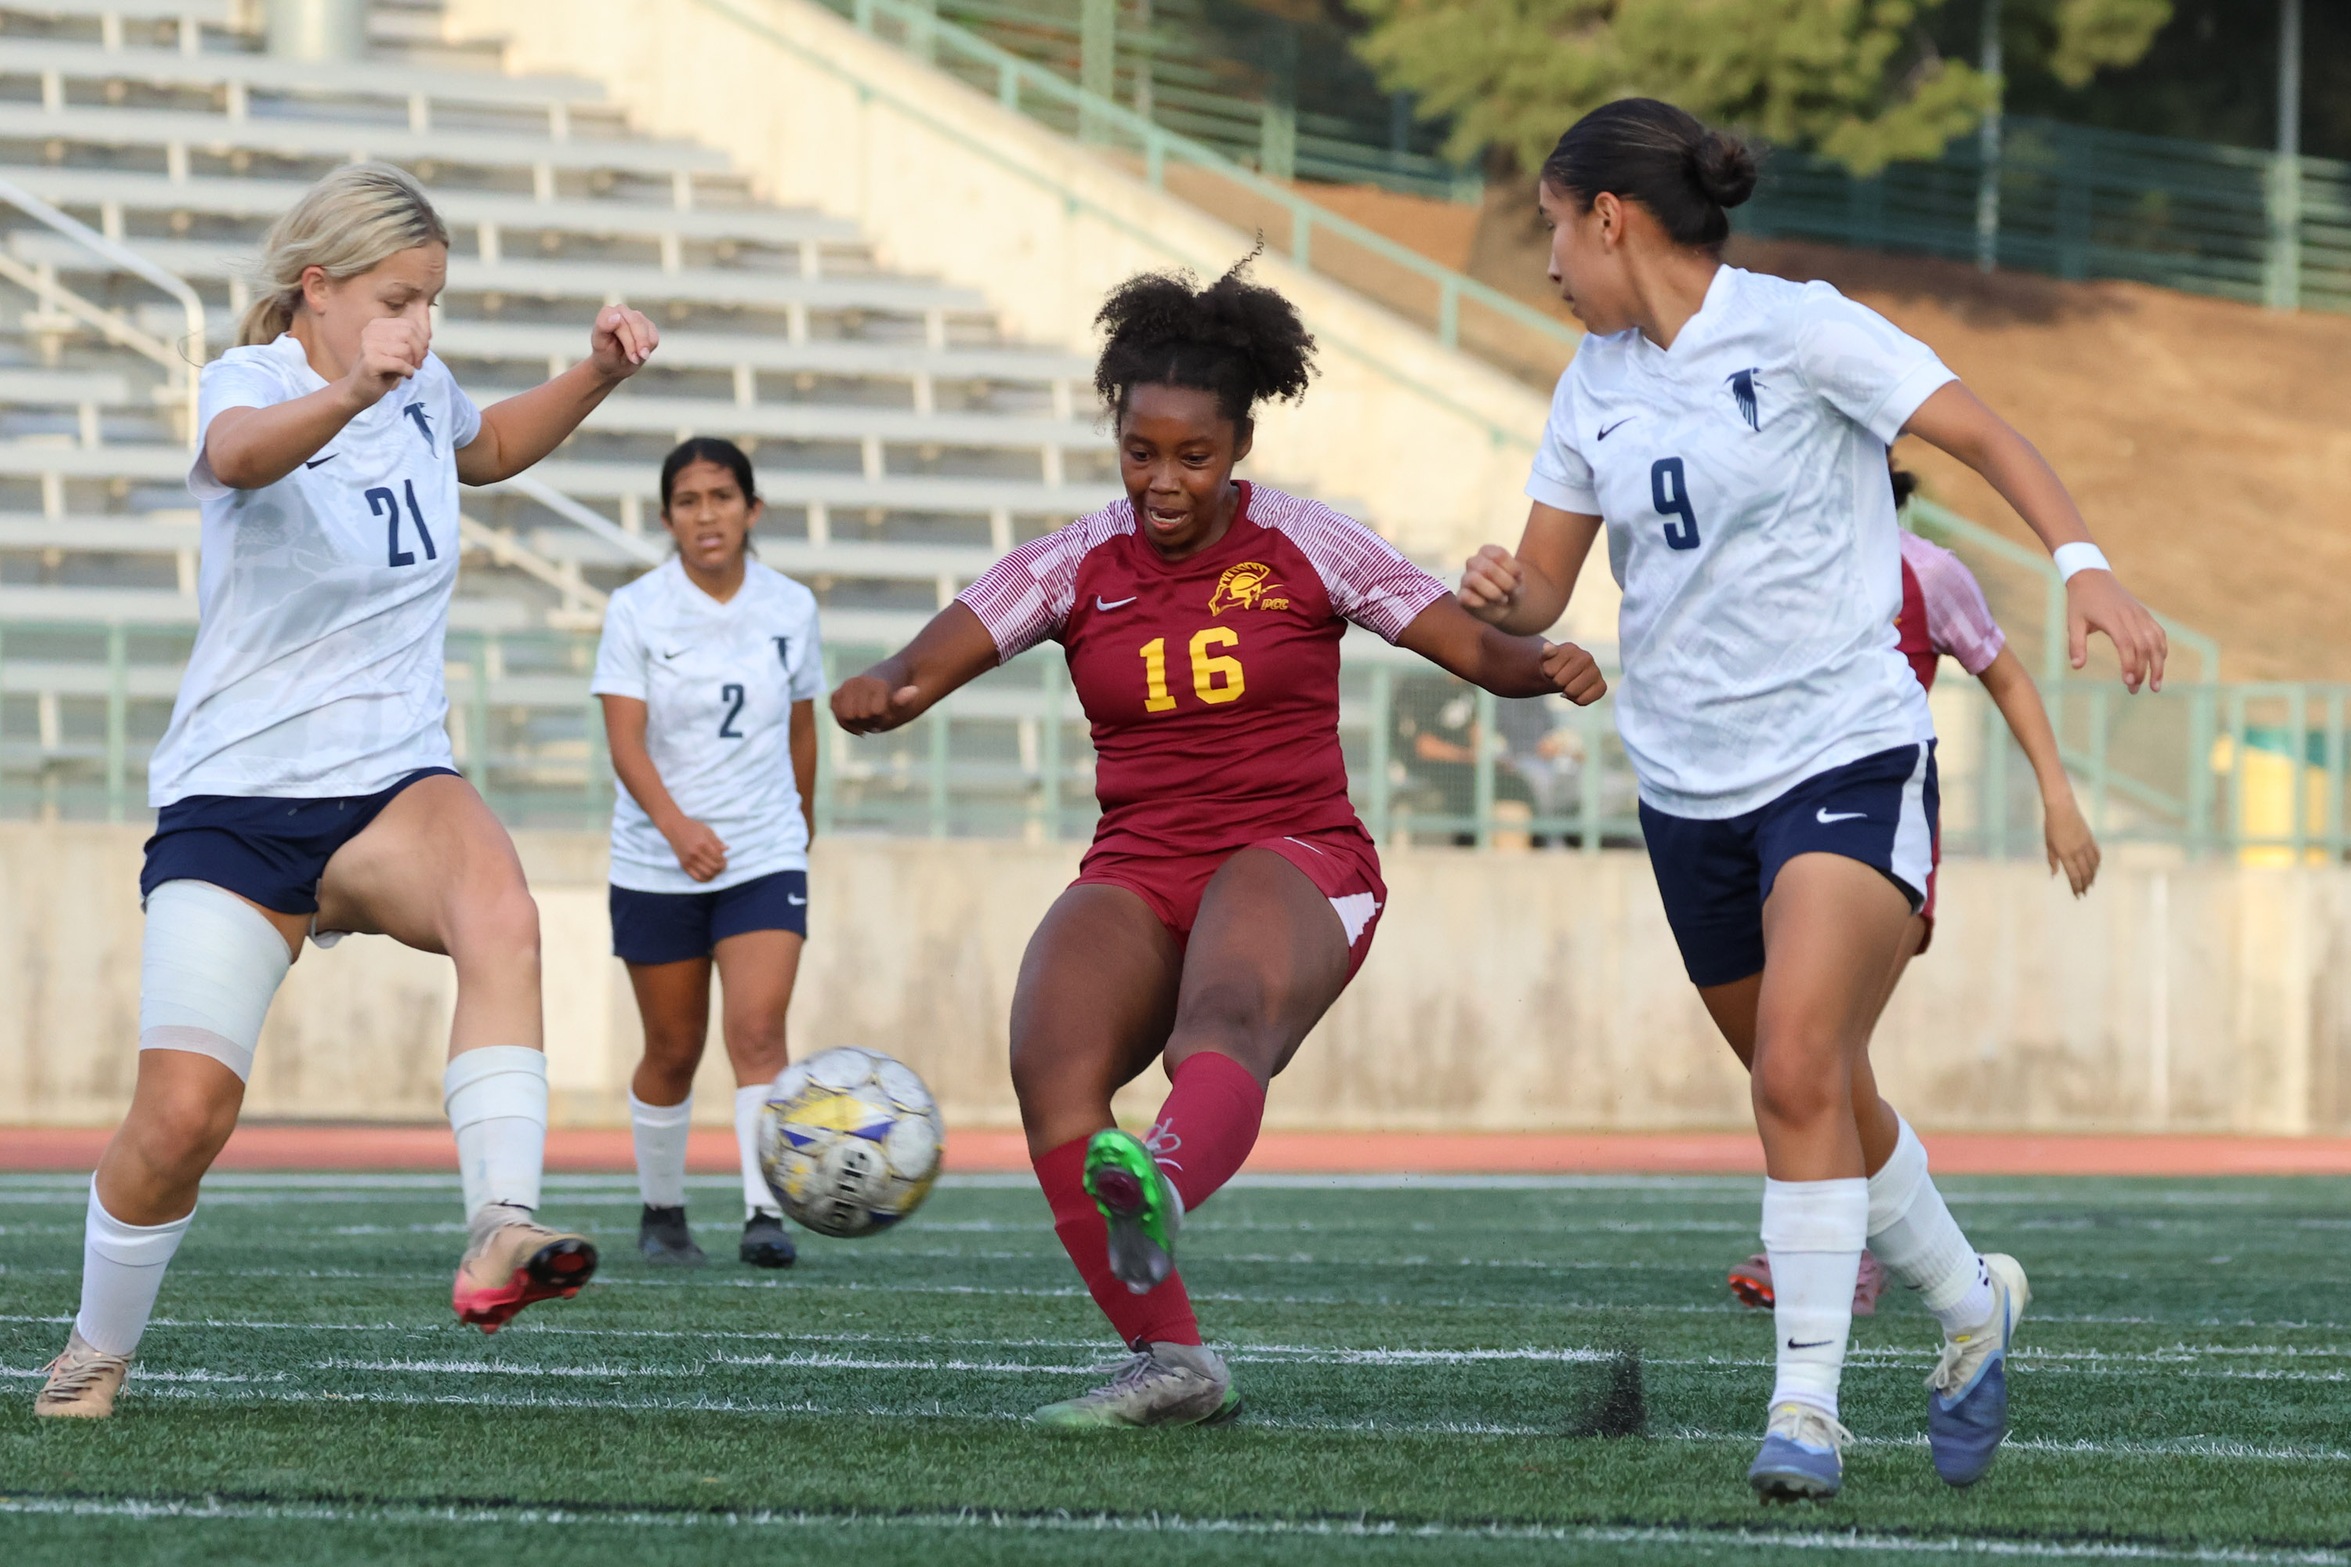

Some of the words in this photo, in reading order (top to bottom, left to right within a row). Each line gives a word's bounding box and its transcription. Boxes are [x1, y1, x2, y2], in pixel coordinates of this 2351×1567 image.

[364, 479, 437, 567] 21
[1651, 456, 1700, 550] 9
[1260, 598, 1290, 611] PCC
[719, 683, 745, 738] 2
[1139, 626, 1246, 713] 16
